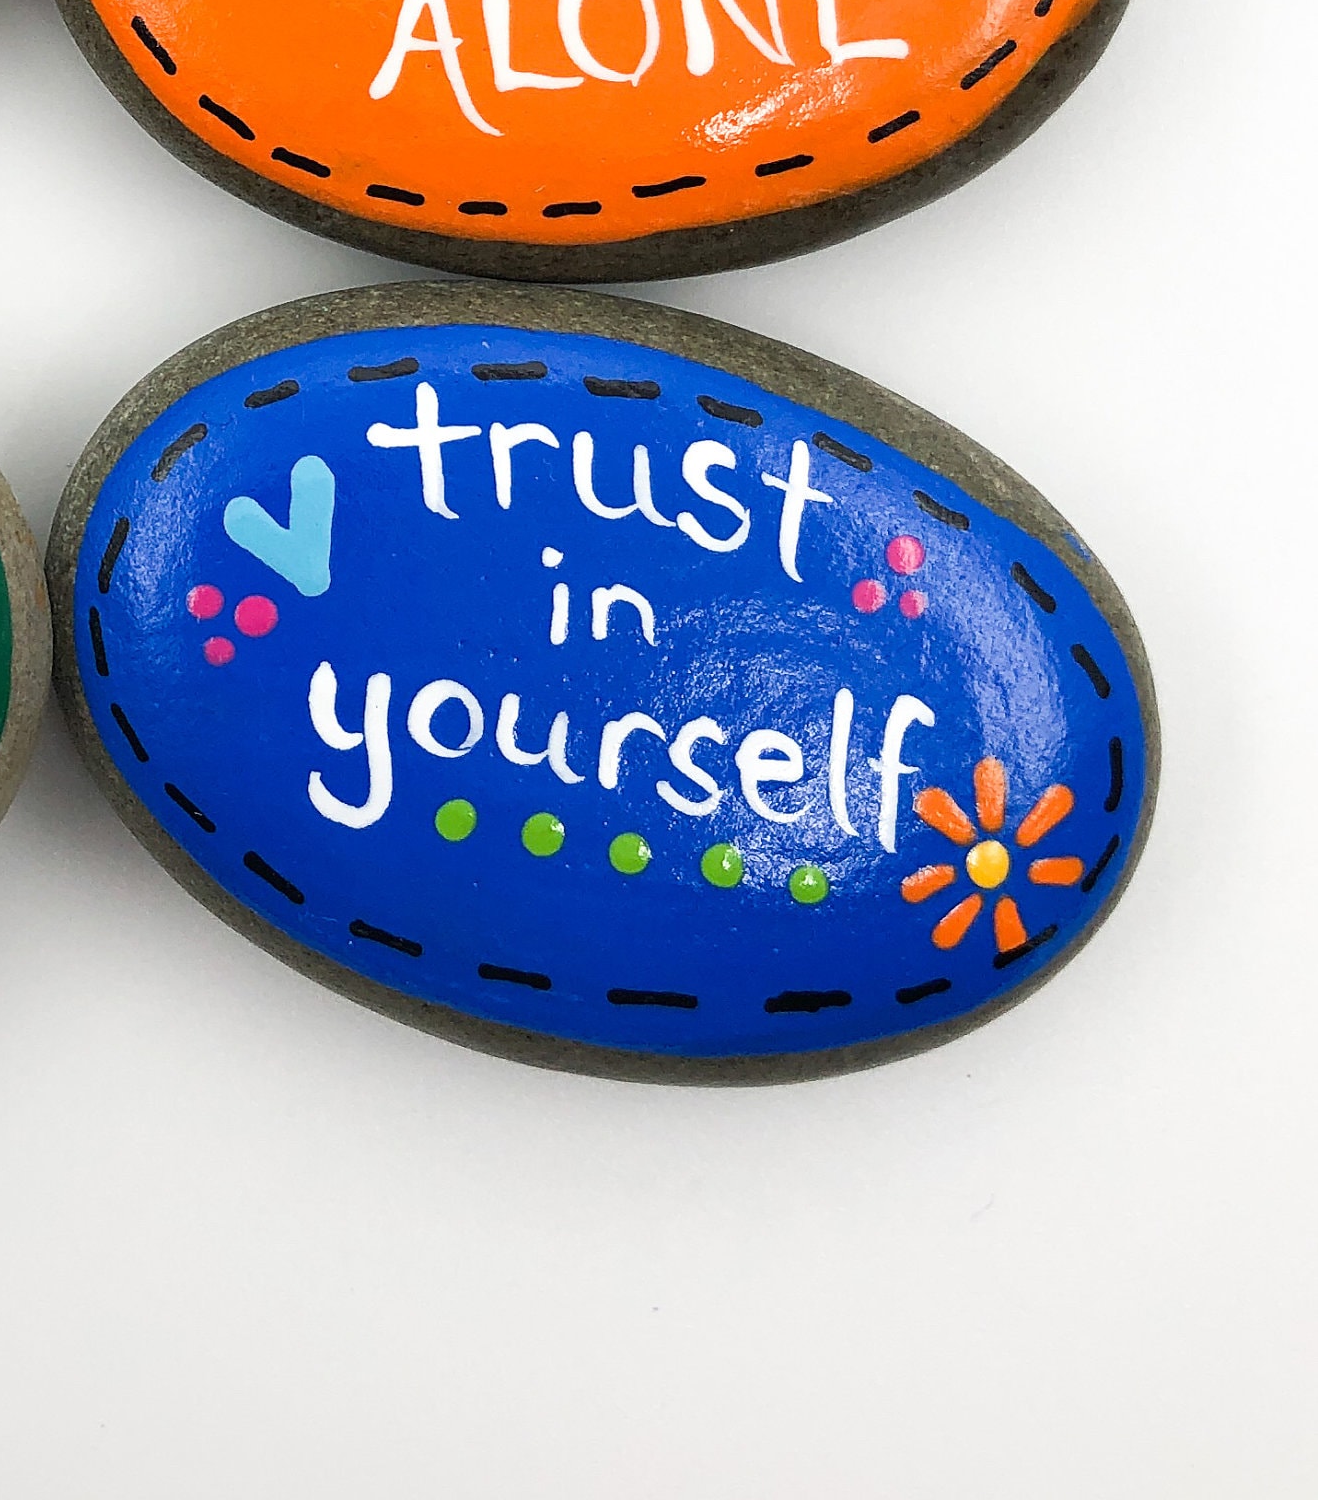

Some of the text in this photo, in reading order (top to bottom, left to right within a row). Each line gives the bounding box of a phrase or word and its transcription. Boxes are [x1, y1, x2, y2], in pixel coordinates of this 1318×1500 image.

[366, 380, 834, 583] trust
[540, 547, 658, 648] in
[306, 660, 936, 856] yourself
